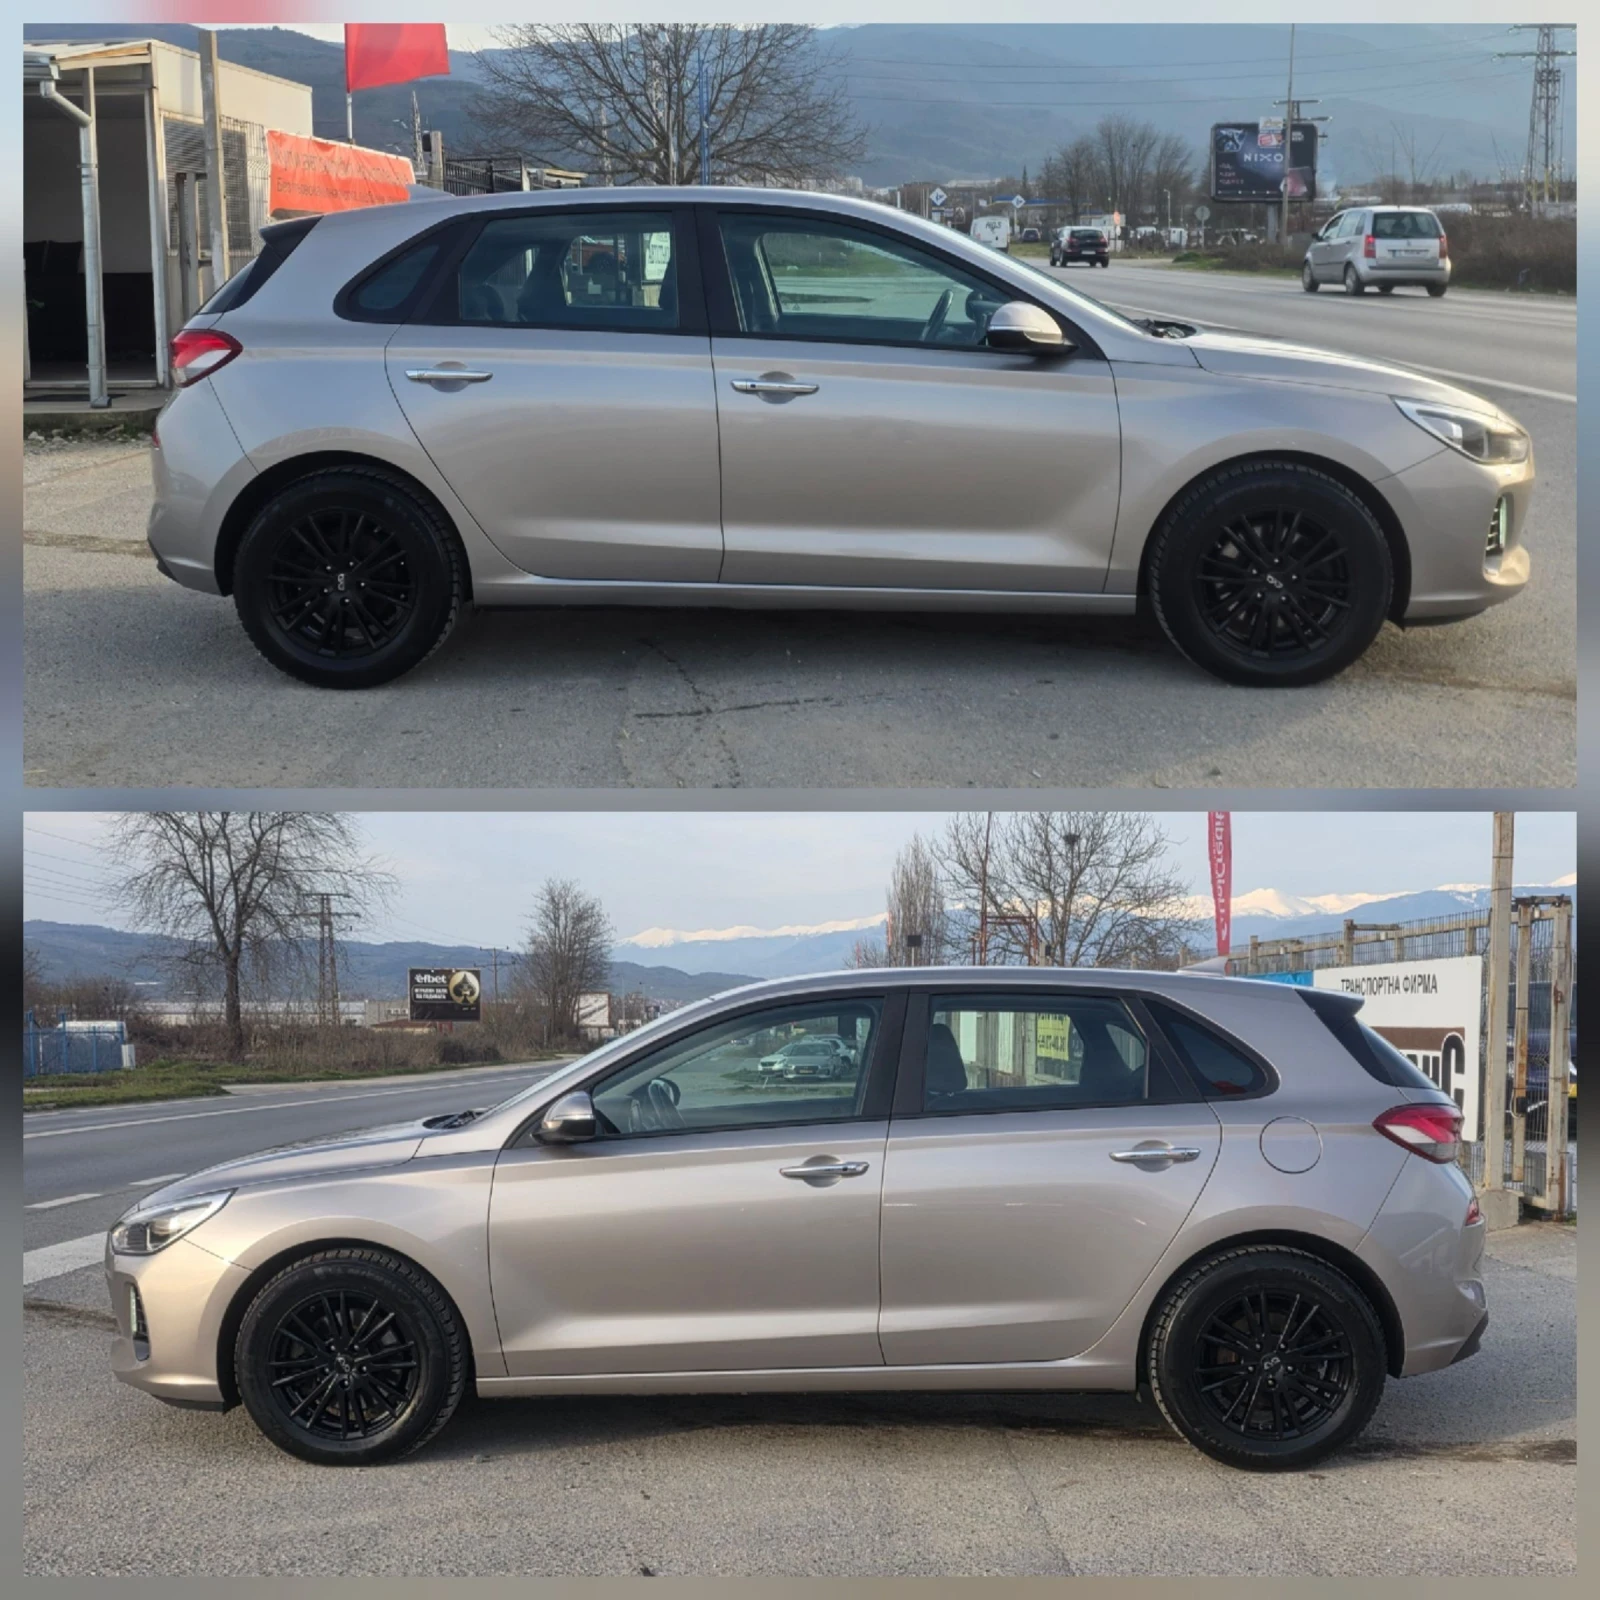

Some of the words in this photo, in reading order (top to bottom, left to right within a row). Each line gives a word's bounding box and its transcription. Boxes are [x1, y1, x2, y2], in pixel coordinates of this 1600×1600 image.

[1244, 153, 1284, 162] NIXO
[415, 973, 447, 984] efbet
[1341, 975, 1400, 996] ТРАНСПОРТНА
[1402, 973, 1438, 994] ФИРМА
